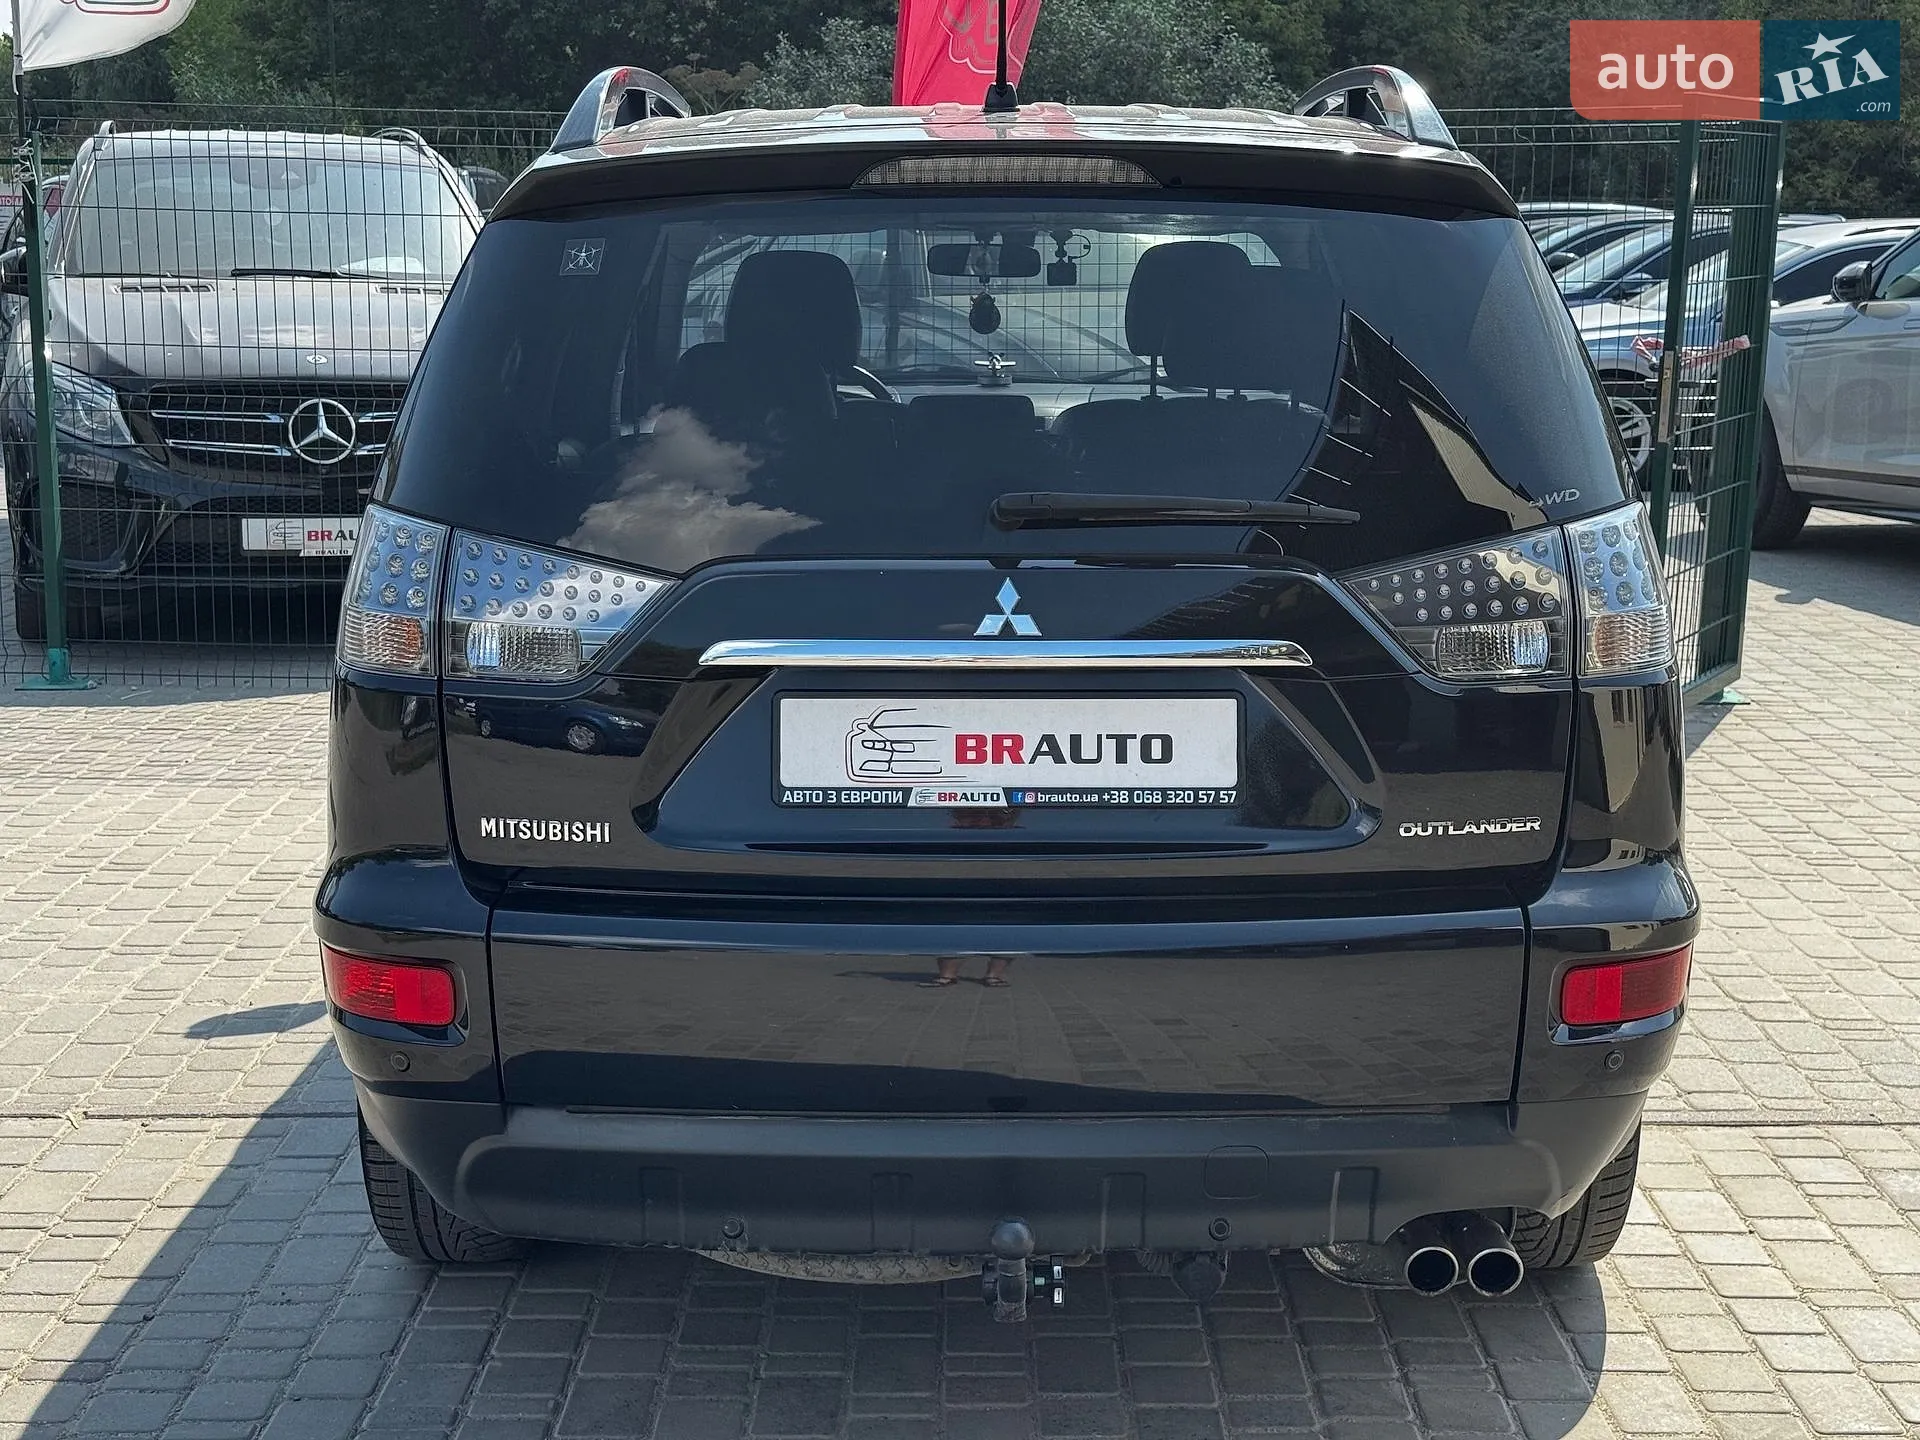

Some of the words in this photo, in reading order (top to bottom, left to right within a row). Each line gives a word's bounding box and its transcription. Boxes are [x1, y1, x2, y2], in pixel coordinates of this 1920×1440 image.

[955, 733, 1174, 765] BRAUTO
[782, 790, 822, 803] АВТО
[842, 790, 903, 803] ЄВРОПИ
[937, 791, 1001, 803] BRAUTO
[1037, 791, 1099, 803] brauto.ua
[1102, 790, 1129, 803] +38
[1133, 790, 1162, 803] 068
[1166, 790, 1194, 803] 320
[1198, 790, 1215, 803] 57
[1219, 790, 1237, 803] 57
[480, 817, 611, 844] MITSUBISHI
[1398, 816, 1542, 838] OUTLANDER
